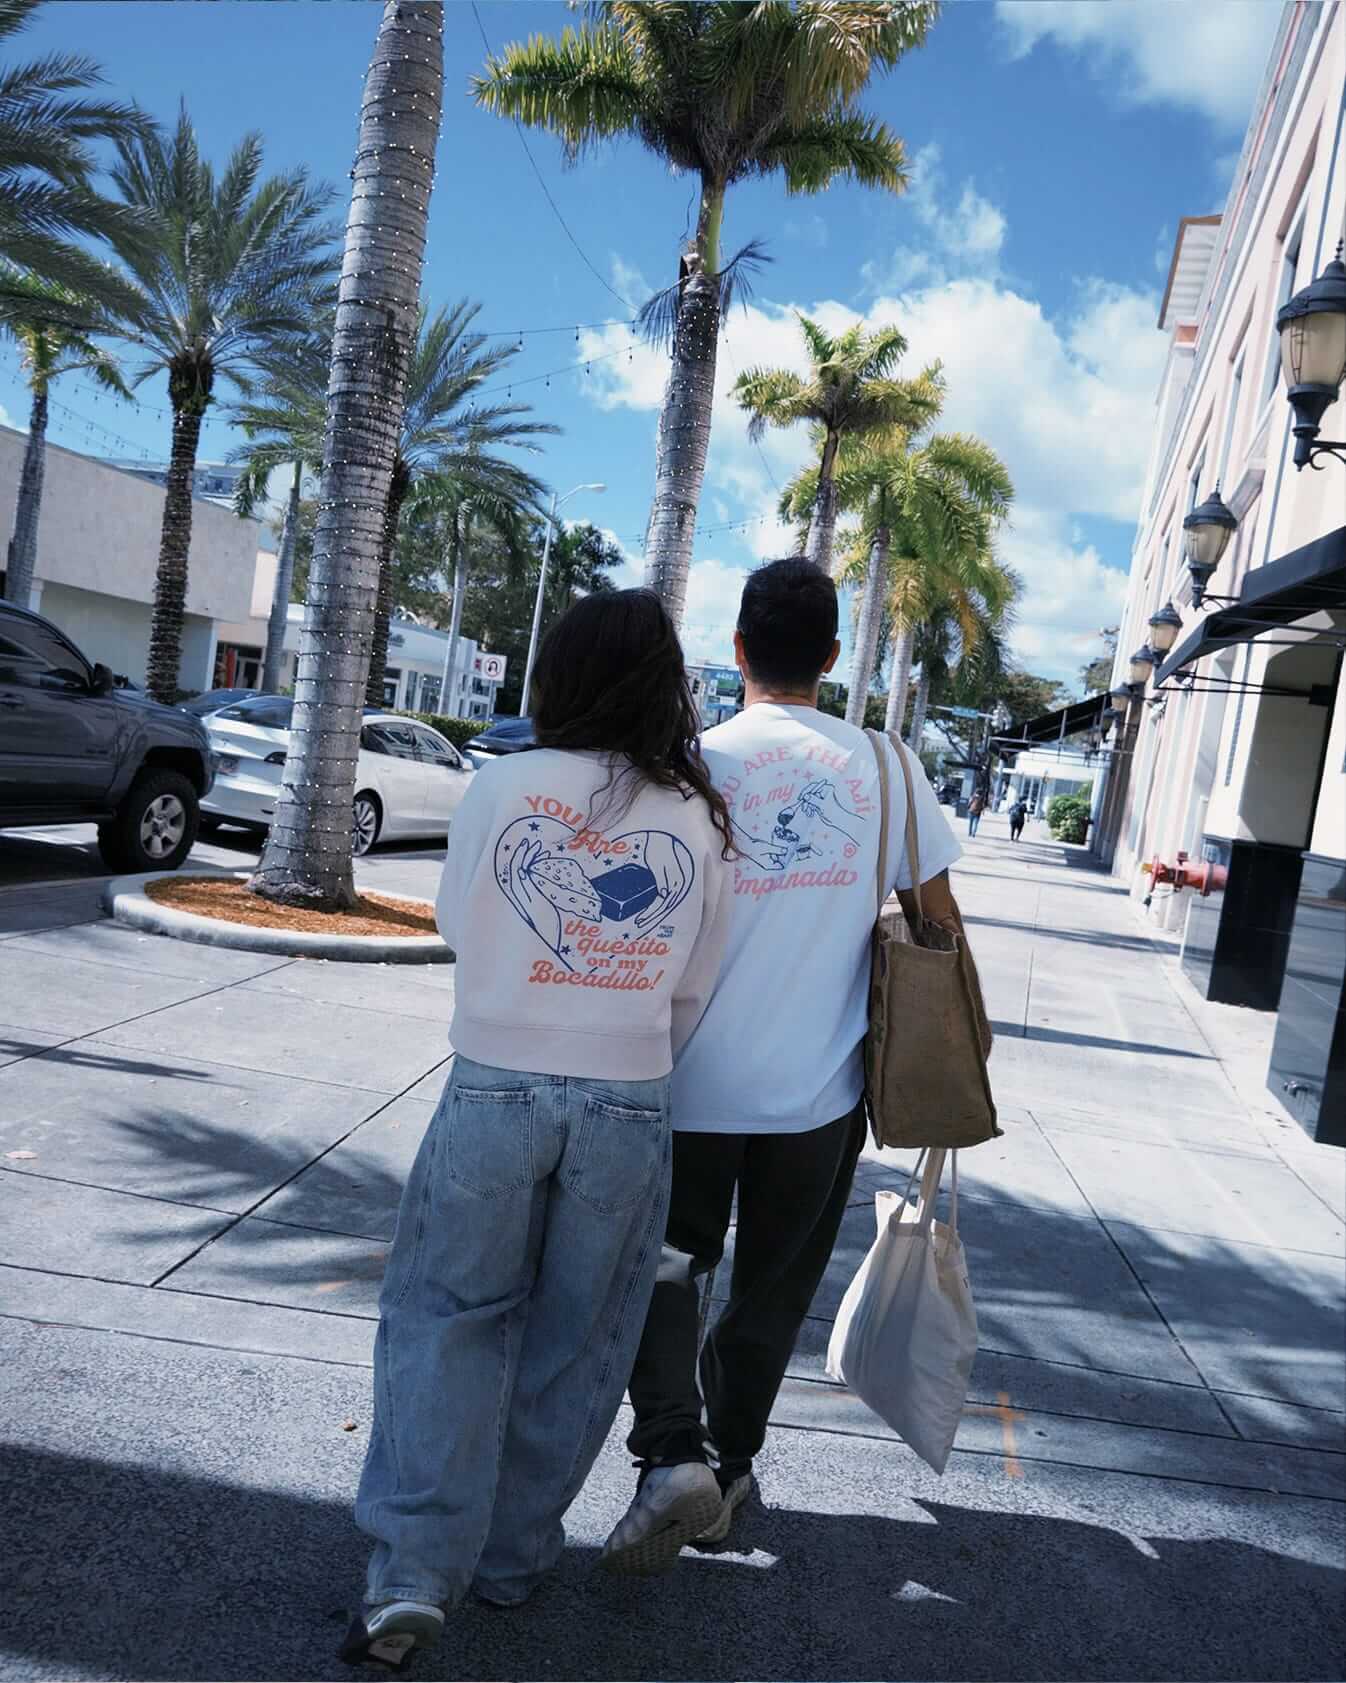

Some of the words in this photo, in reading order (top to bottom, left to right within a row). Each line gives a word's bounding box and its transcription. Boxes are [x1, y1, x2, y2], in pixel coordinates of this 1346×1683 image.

[743, 746, 792, 776] ARE
[803, 745, 849, 774] THE
[525, 795, 585, 826] YOU
[743, 792, 761, 811] in
[767, 783, 795, 801] my
[567, 828, 631, 854] Are
[563, 919, 602, 937] the
[528, 959, 664, 991] Bocadillo!
[586, 957, 611, 969] on
[617, 959, 649, 972] my
